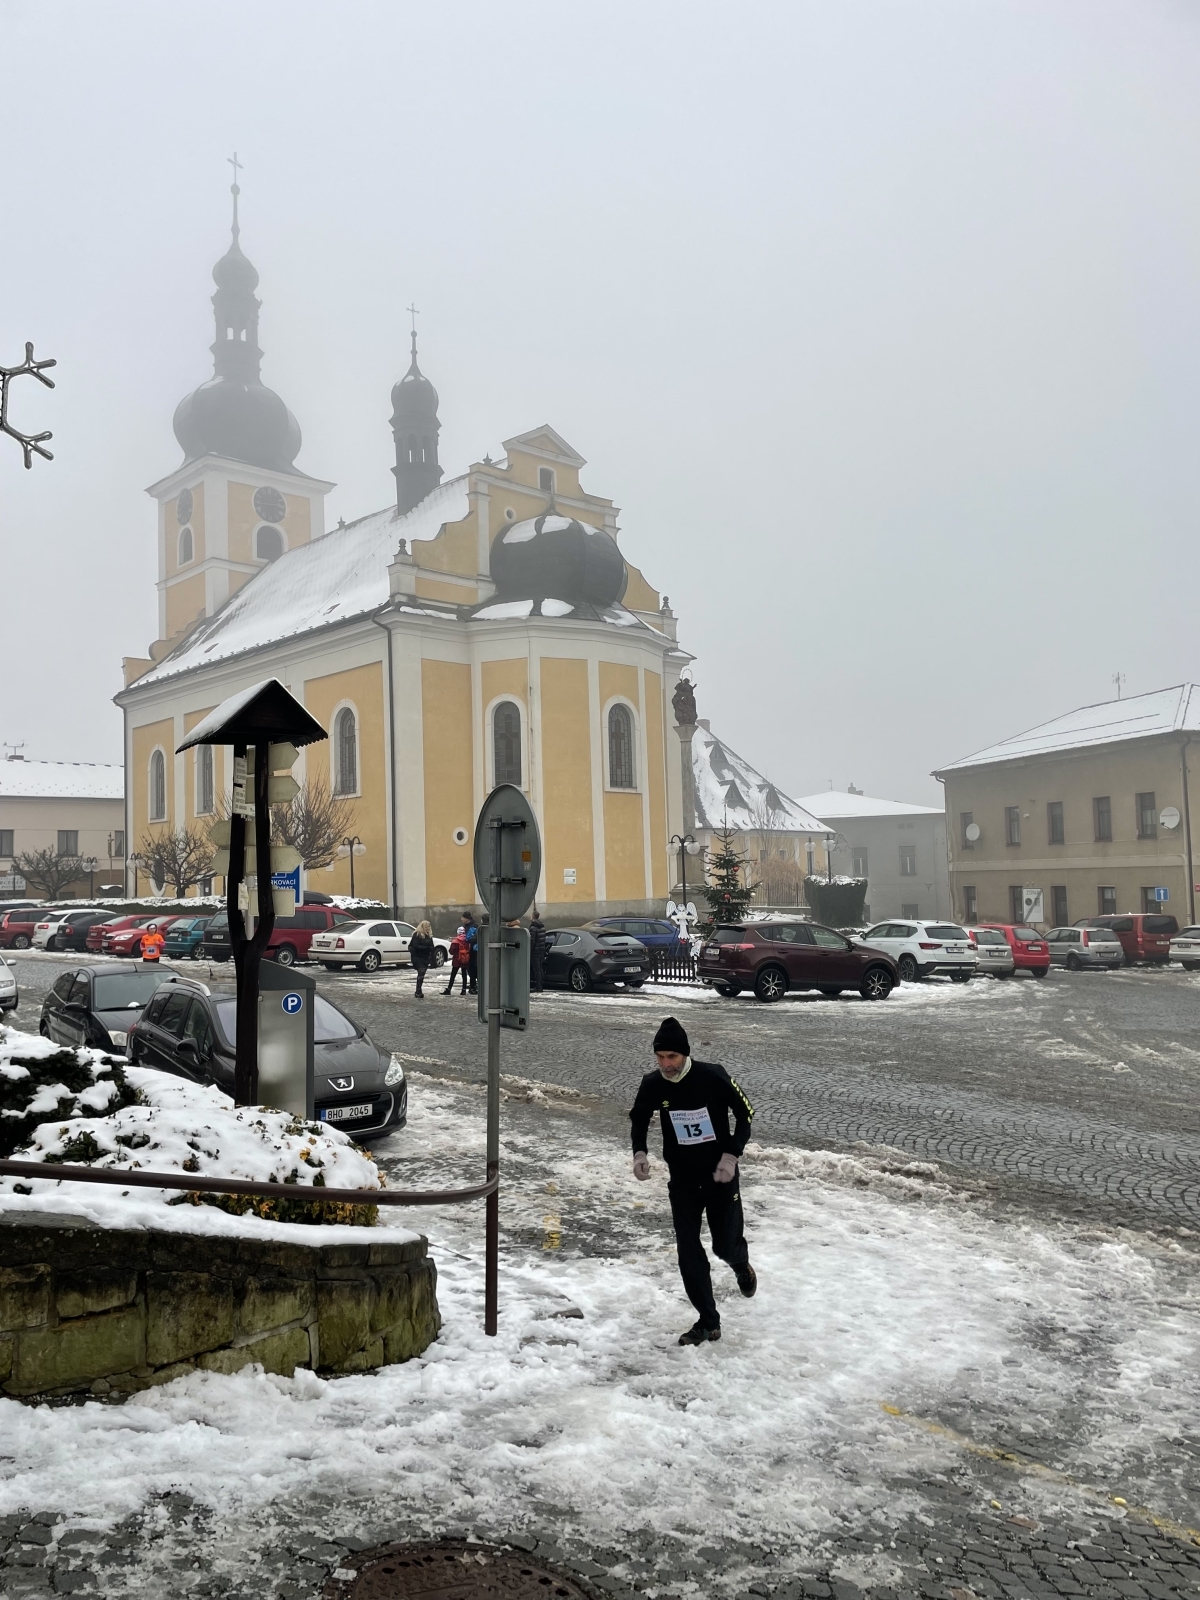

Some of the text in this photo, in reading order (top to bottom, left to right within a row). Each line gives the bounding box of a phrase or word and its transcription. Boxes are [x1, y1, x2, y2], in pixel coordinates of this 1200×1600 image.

[287, 996, 298, 1011] P
[349, 1106, 369, 1116] 2045
[683, 1123, 703, 1138] 13
